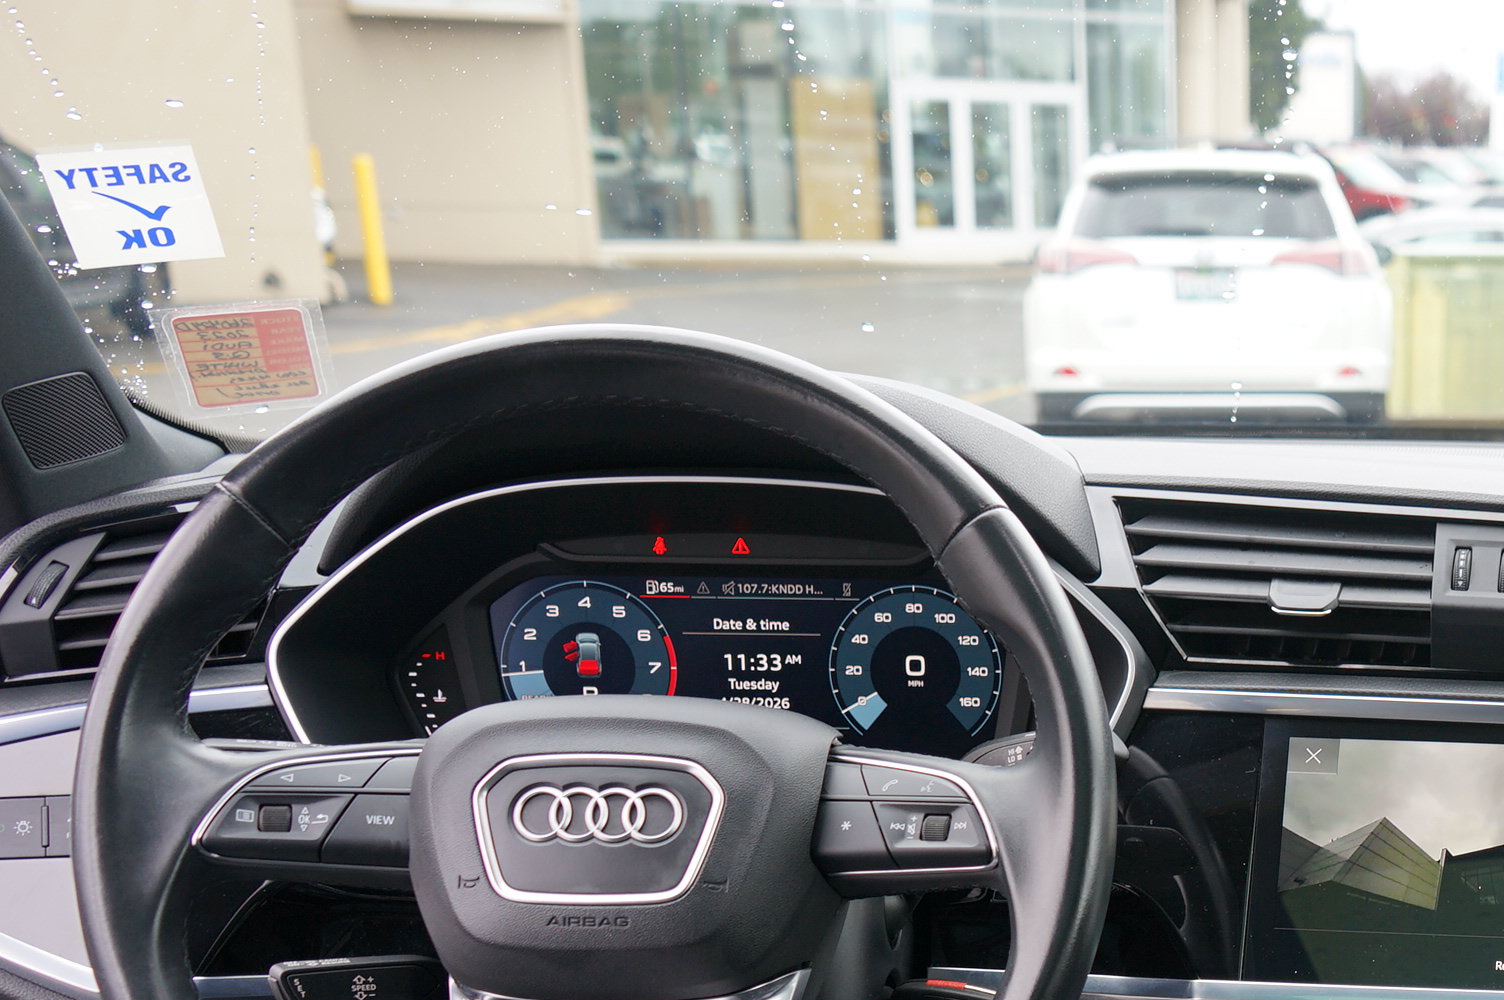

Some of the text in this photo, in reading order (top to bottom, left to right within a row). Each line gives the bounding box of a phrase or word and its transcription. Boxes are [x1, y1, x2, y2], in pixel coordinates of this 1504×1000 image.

[577, 596, 592, 609] 4
[905, 603, 923, 614] 80
[545, 605, 560, 618] 3
[612, 605, 626, 618] 5
[713, 617, 790, 631] Date & time
[874, 612, 892, 624] 60
[934, 613, 956, 624] 100
[523, 628, 538, 641] 2
[637, 629, 652, 642] 6
[851, 634, 869, 645] 40
[957, 635, 979, 646] 120
[435, 651, 446, 661] H
[519, 660, 527, 672] 1
[648, 662, 662, 674] 7
[723, 653, 802, 672] 11:33 AM
[905, 655, 926, 677] 0
[845, 665, 863, 676] 20
[966, 666, 989, 677] 140
[728, 677, 780, 693] Tuesday
[907, 680, 924, 688] MPH
[959, 697, 981, 708] 160
[298, 814, 311, 824] OK
[365, 815, 395, 825] VIEW
[546, 916, 631, 928] AIRBAG
[351, 983, 377, 993] SPEED
